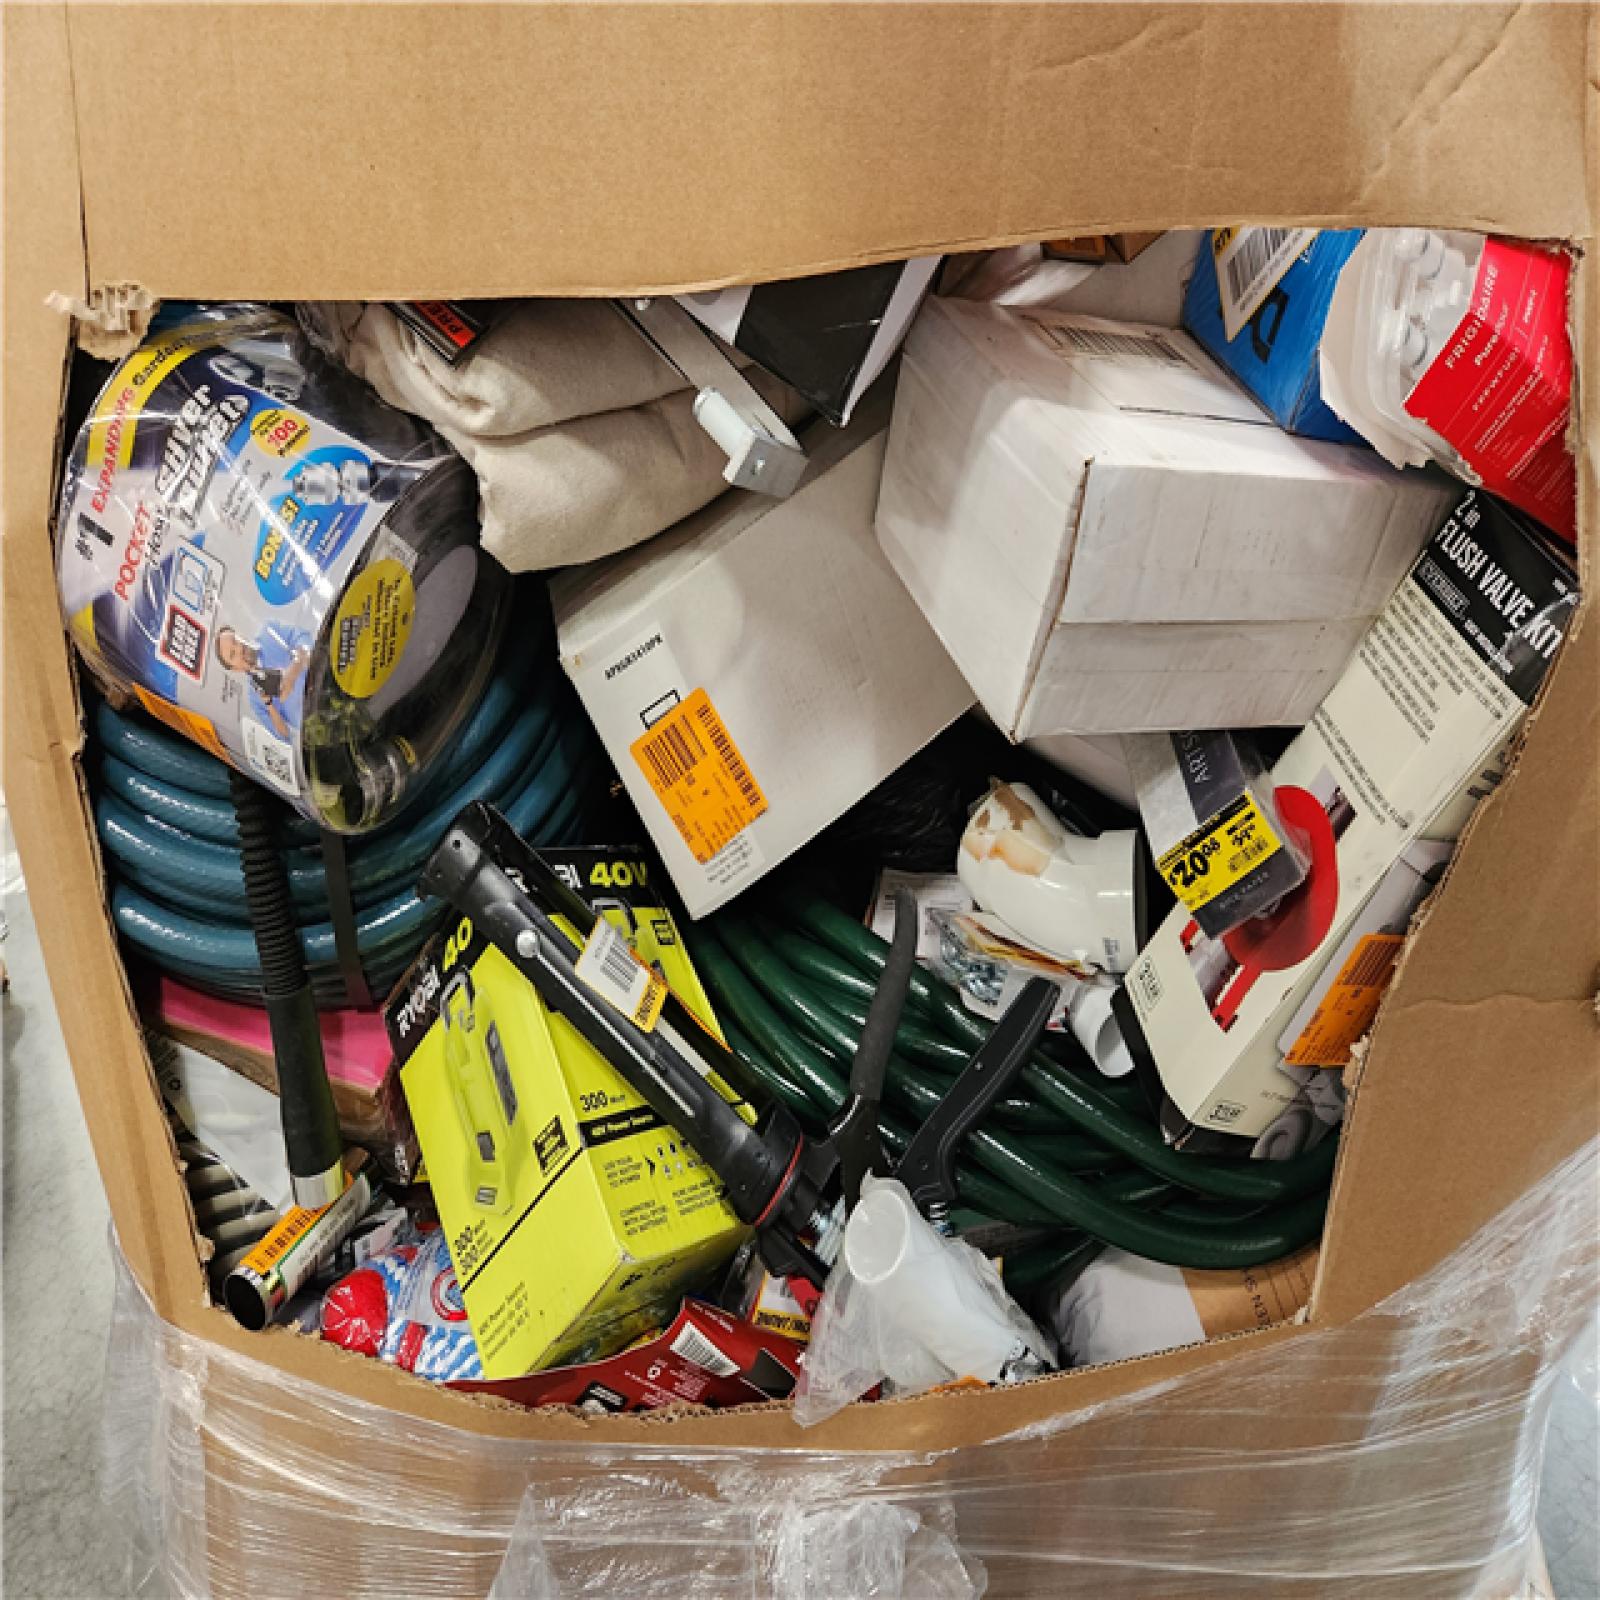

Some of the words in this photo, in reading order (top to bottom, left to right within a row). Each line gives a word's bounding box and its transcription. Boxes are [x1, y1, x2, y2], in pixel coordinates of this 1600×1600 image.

[1443, 264, 1500, 369] FRIGIDAIRE
[1436, 520, 1488, 580] FLUSH
[1478, 562, 1535, 627] VALVE
[1522, 615, 1562, 659] KIT
[589, 861, 648, 889] 40V
[579, 1089, 607, 1112] 300
